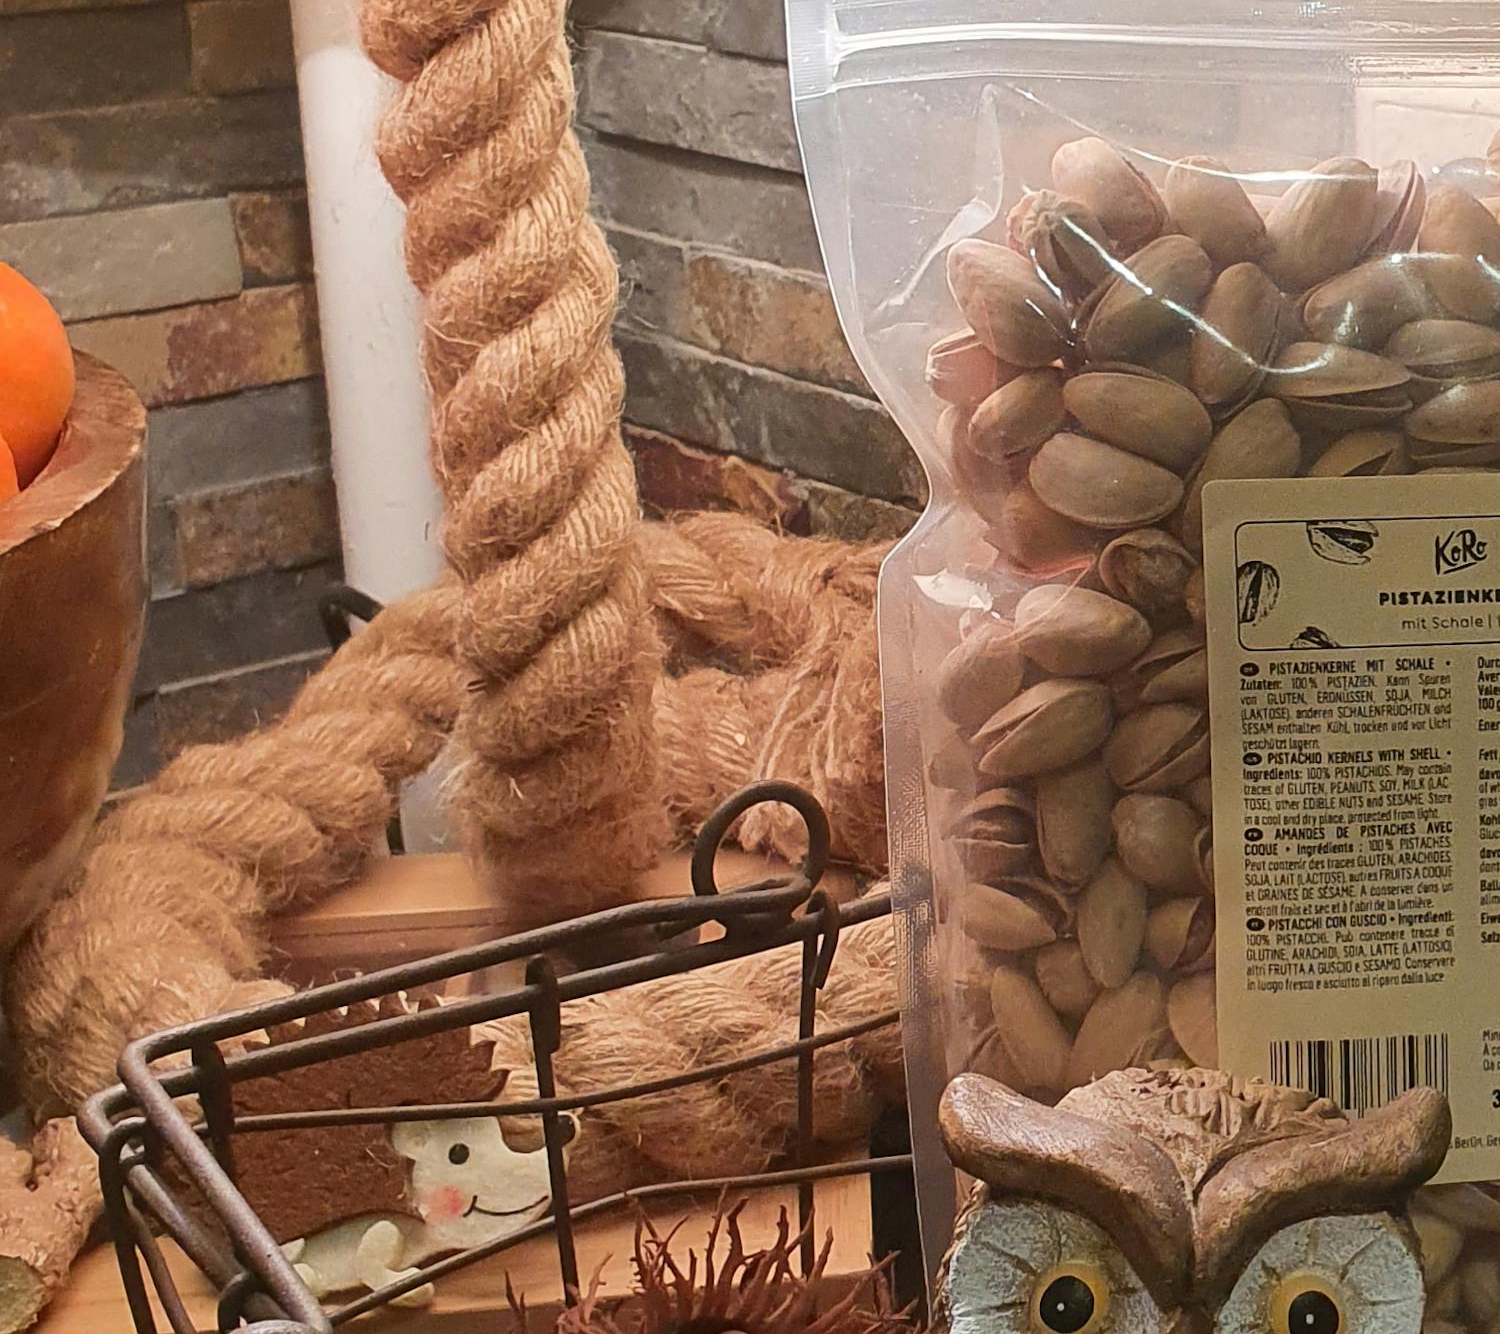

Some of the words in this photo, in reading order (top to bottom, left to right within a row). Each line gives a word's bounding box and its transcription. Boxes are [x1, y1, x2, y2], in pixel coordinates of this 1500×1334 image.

[1434, 528, 1488, 575] KoRo
[1402, 617, 1427, 630] mit
[1432, 616, 1484, 630] Schale
